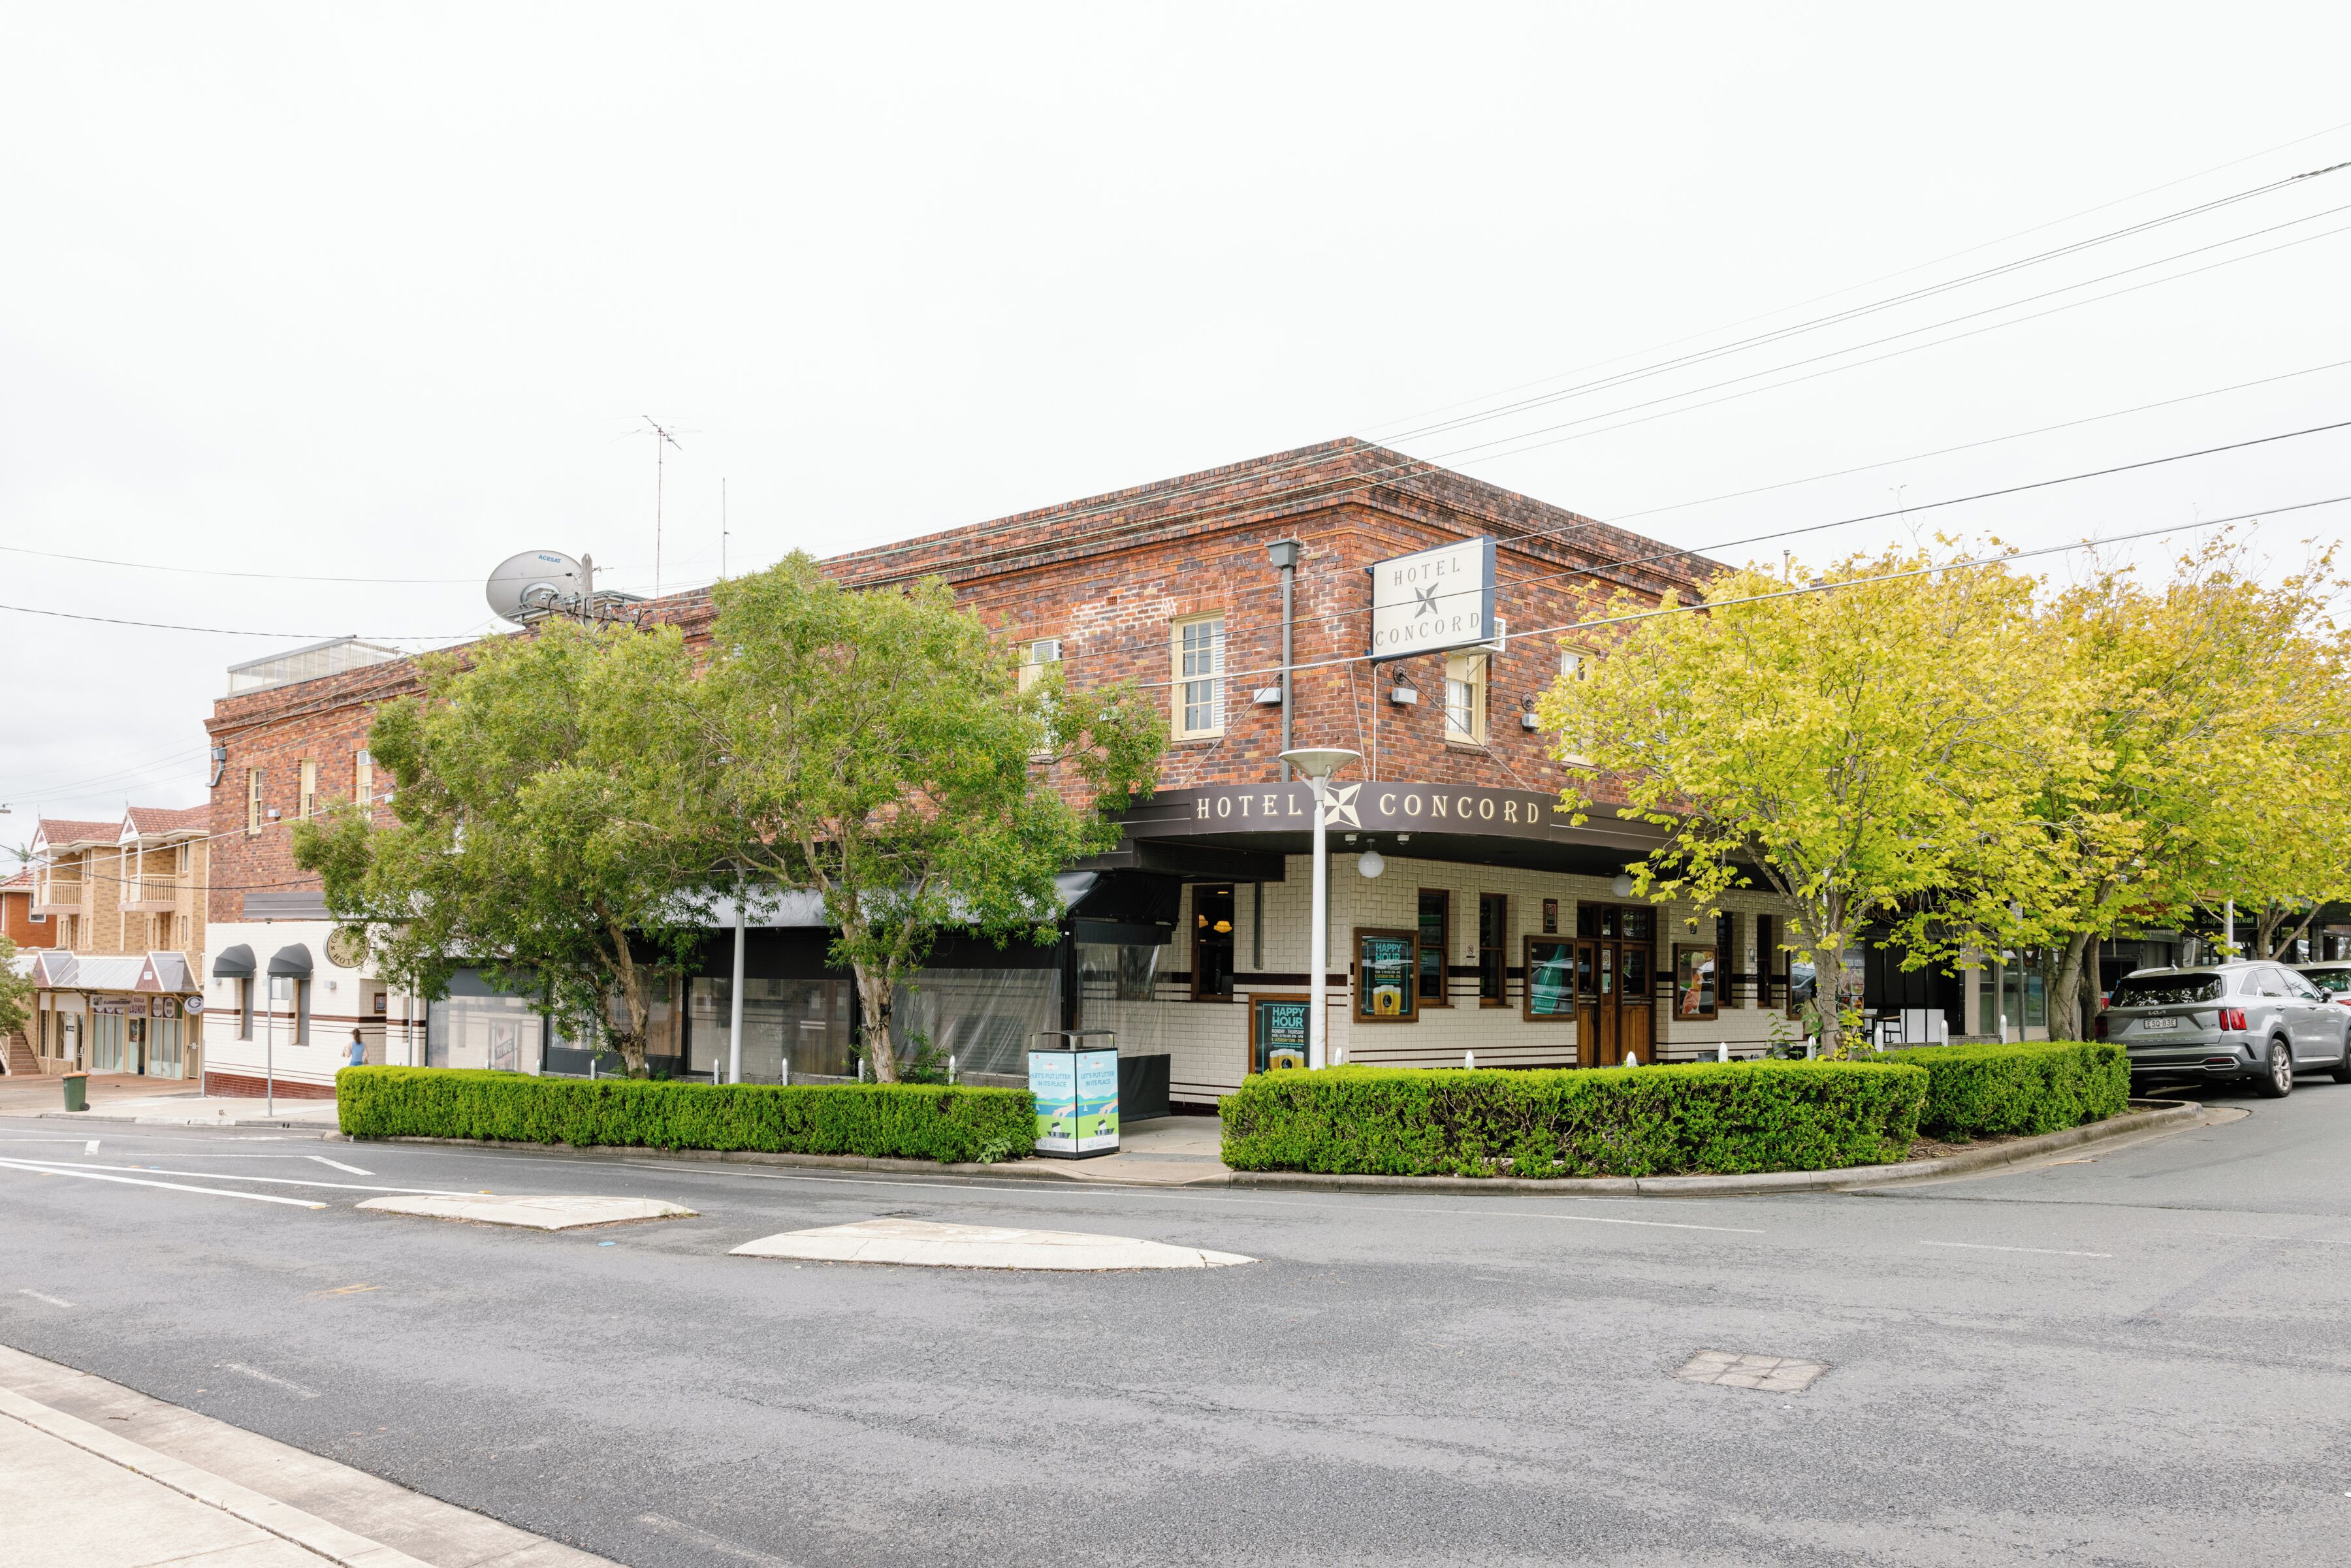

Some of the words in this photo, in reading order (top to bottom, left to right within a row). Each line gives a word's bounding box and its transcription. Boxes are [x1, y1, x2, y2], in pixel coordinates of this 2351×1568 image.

[538, 554, 561, 563] ACESAT
[1394, 558, 1460, 586] HOTEL
[1375, 613, 1479, 647] CONCORD
[1196, 794, 1303, 819] HOTEL
[1379, 793, 1539, 824] CONCORD
[1375, 943, 1401, 953] HAPPY
[1375, 952, 1401, 963] HOUR
[1273, 1007, 1305, 1017] HAPPY
[1272, 1016, 1303, 1027] HOUR
[496, 1040, 512, 1059] KING
